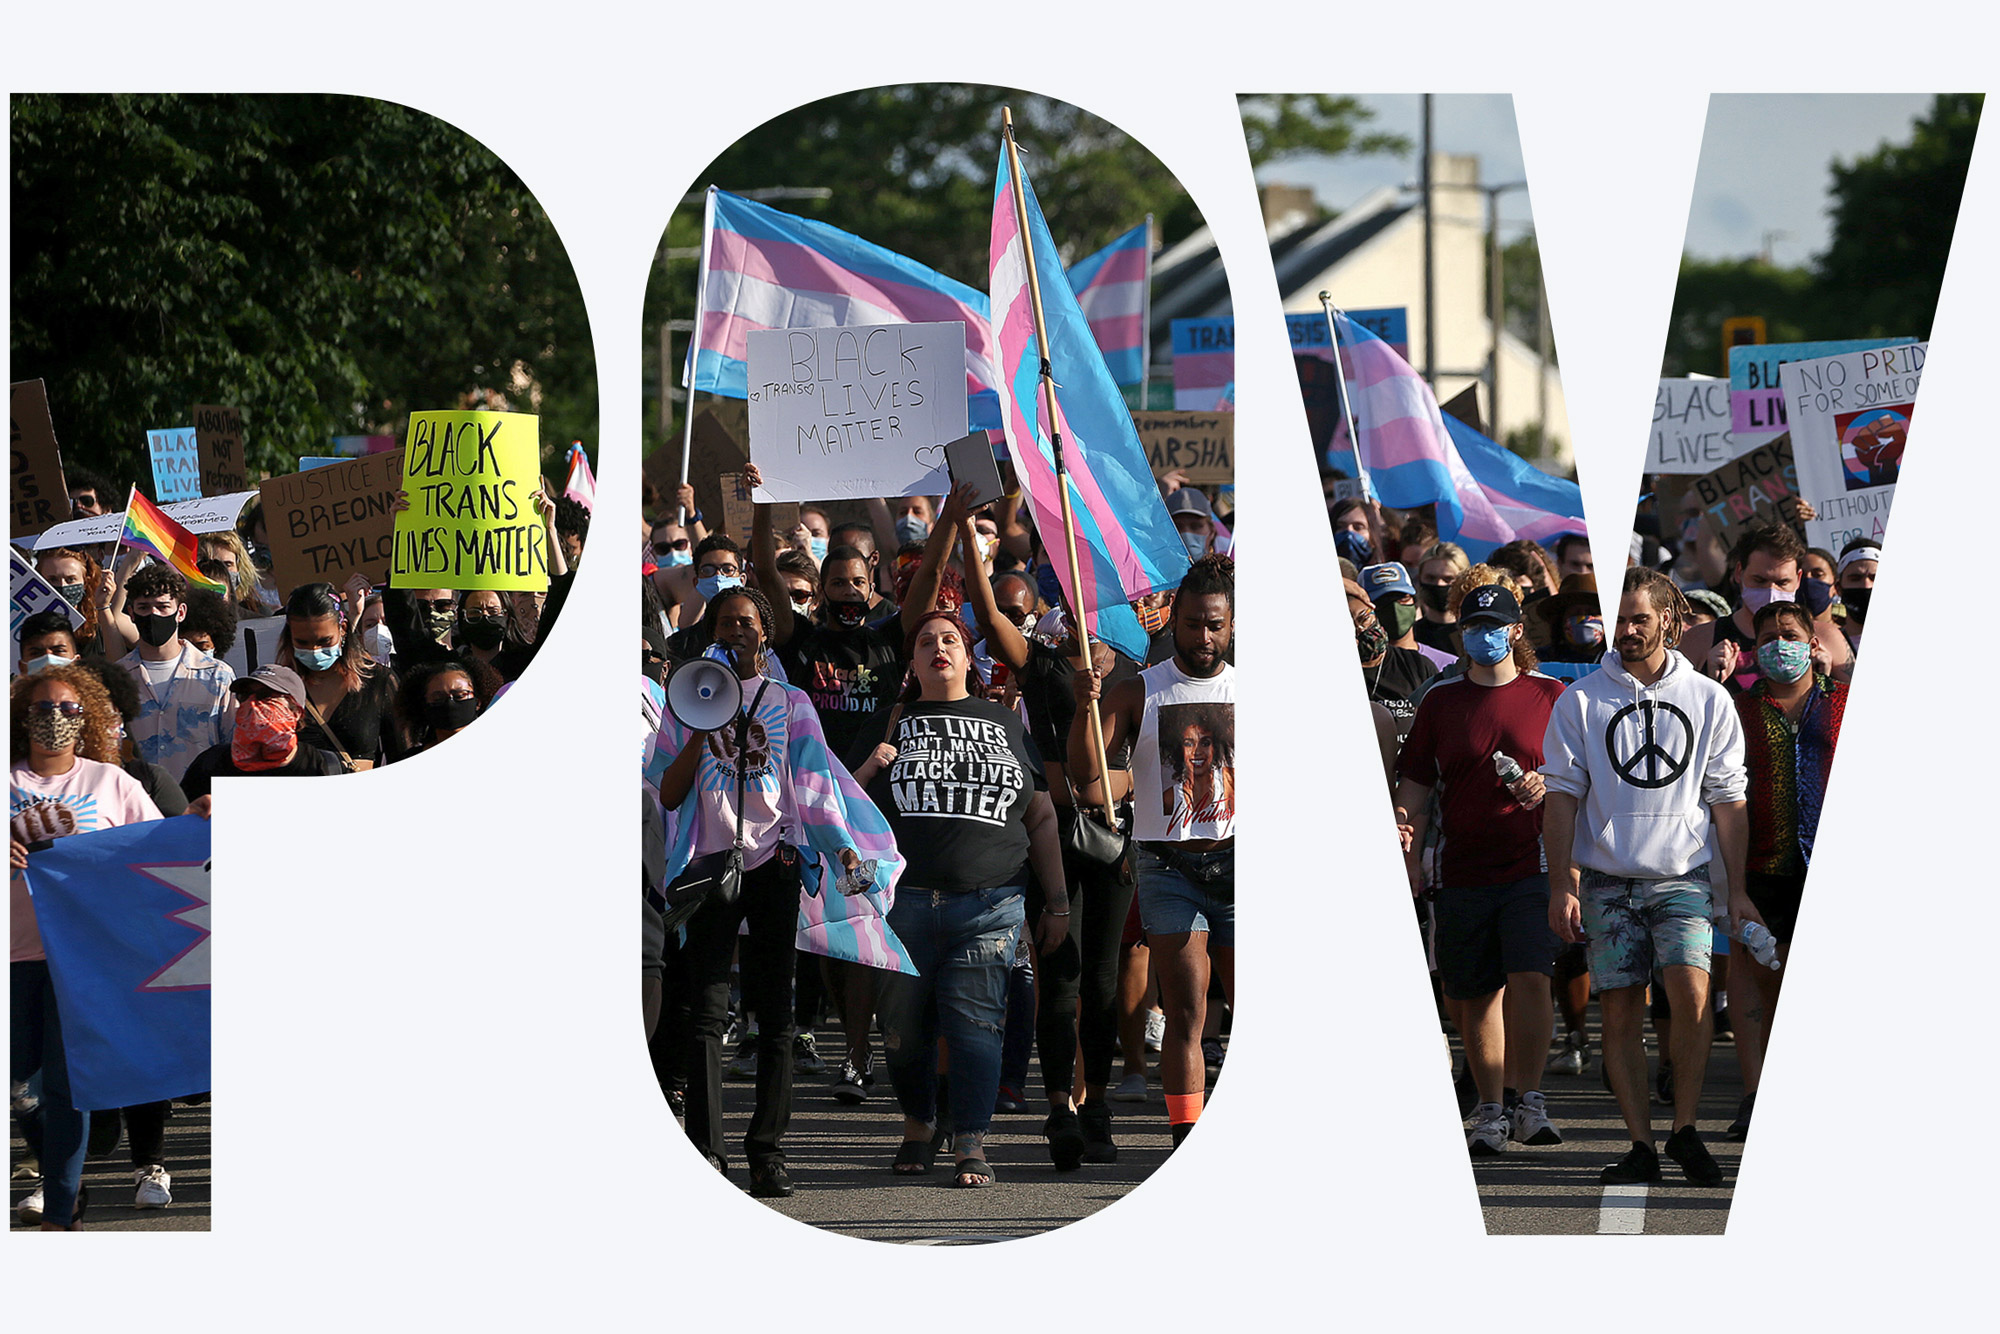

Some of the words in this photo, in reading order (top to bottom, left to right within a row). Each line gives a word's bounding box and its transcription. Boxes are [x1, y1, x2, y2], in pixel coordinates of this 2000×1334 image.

[787, 328, 924, 383] BLACK
[1800, 360, 1846, 392] NO
[1863, 345, 1929, 379] PRID
[762, 381, 804, 401] TRANS
[820, 380, 925, 416] LIVES
[1798, 388, 1844, 415] FOR
[212, 439, 234, 463] NOT
[409, 418, 502, 477] BLACK
[797, 416, 904, 456] MATTER
[276, 462, 372, 507] JUSTICE
[1696, 441, 1794, 505] BLACK
[420, 480, 518, 520] TRANS
[394, 525, 449, 575] LIVES
[454, 523, 547, 577] MATTER
[812, 694, 860, 713] PROUD
[898, 719, 937, 741] ALL
[945, 718, 1009, 748] LIVES
[899, 737, 943, 754] CAN'T
[951, 738, 1015, 758] MATTER
[890, 761, 957, 782] BLACK
[968, 763, 1024, 790] LIVES
[931, 750, 986, 763] UNTIL
[891, 781, 1018, 822] MATTER
